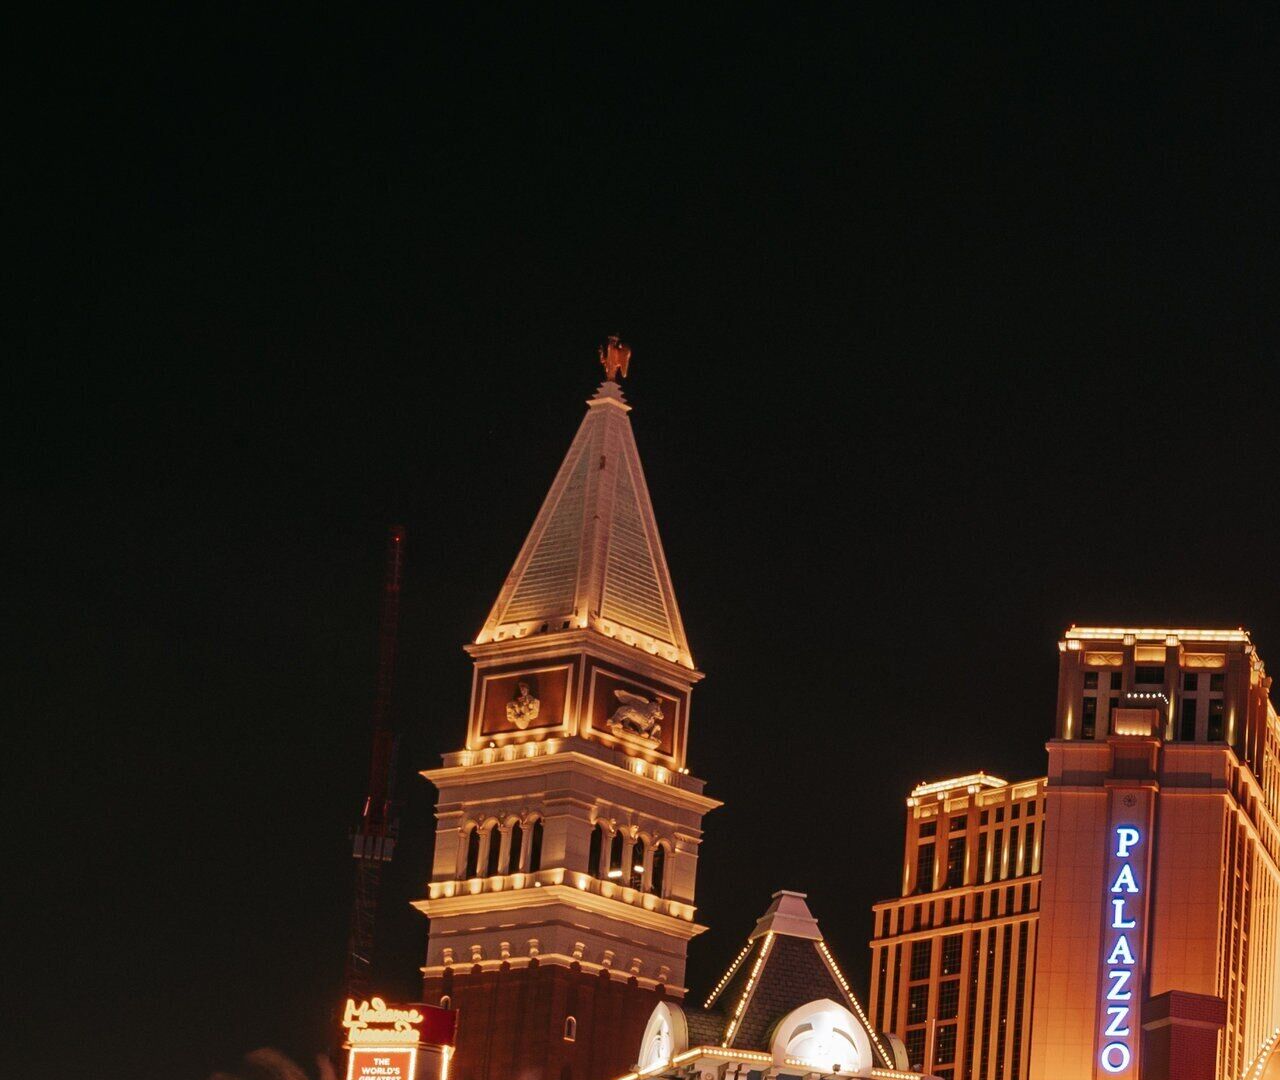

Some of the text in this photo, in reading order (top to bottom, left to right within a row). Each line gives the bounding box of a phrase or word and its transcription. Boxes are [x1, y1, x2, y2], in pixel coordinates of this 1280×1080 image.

[1101, 828, 1140, 1073] PALAZZO
[373, 1058, 390, 1066] THE
[361, 1067, 401, 1075] WORLD'S
